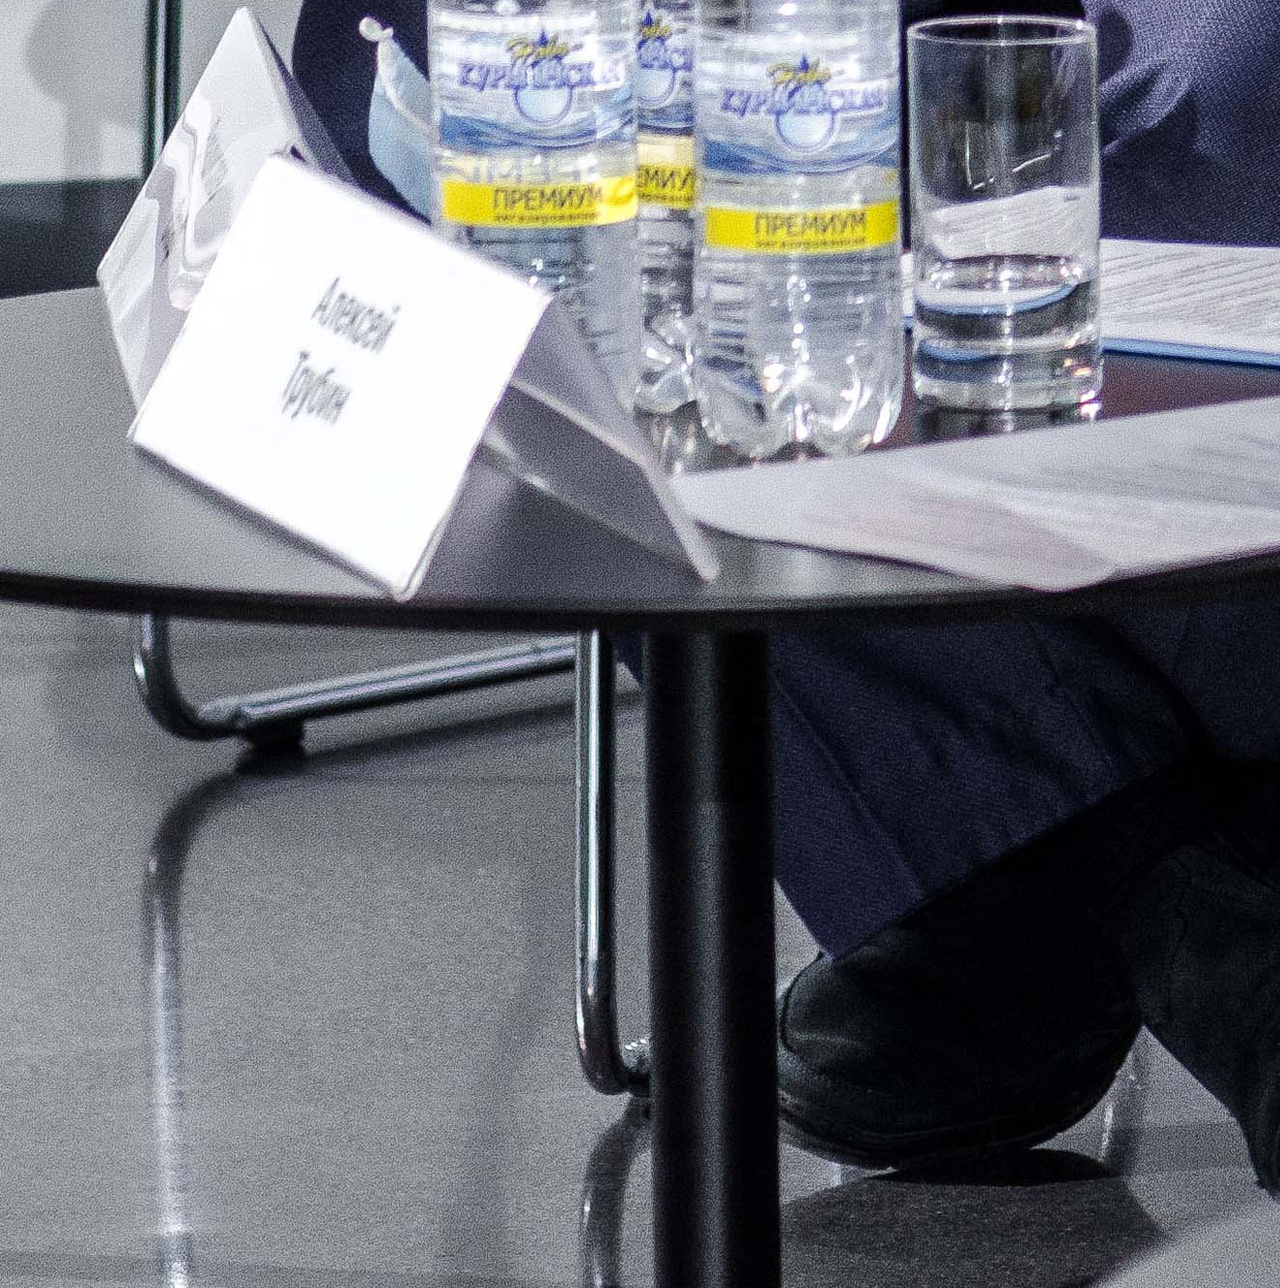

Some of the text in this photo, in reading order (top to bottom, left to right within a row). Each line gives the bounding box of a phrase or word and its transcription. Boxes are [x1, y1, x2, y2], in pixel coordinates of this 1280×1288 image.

[493, 184, 602, 210] ПРЕМИУМ
[755, 212, 866, 236] ПРЕМИУМ
[311, 276, 400, 353] Алексей
